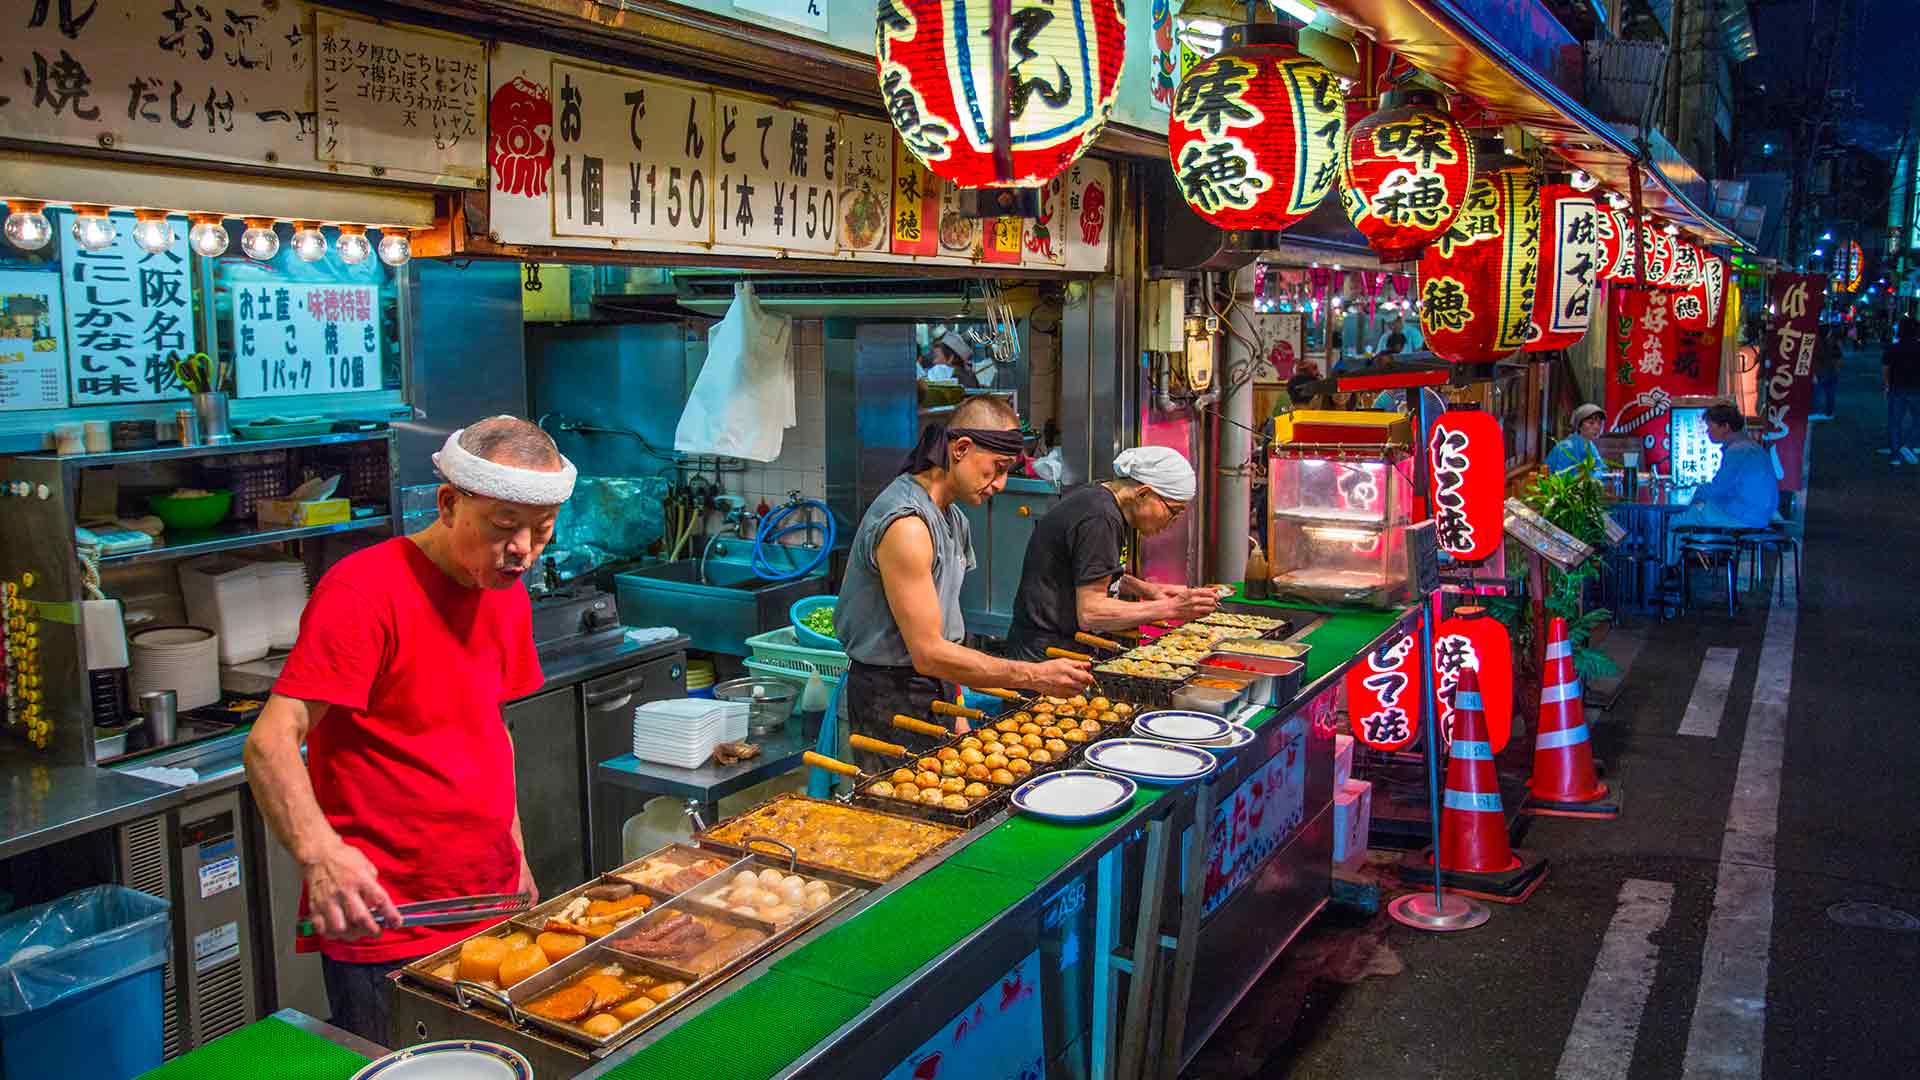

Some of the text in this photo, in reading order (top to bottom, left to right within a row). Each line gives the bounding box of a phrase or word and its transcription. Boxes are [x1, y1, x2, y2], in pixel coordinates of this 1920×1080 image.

[339, 38, 353, 73] スジ
[356, 41, 370, 98] タマゴ
[370, 44, 386, 104] 厚揚げ
[386, 47, 401, 104] ひら天
[416, 53, 432, 112] ちくわ
[447, 60, 463, 149] コンニャク
[462, 62, 478, 136] だいこん
[560, 73, 704, 160] おでん
[720, 104, 836, 182] どて焼き
[1175, 60, 1263, 211] 味穂
[560, 153, 705, 229] 1個 ¥150
[1373, 117, 1453, 226] 味穂
[719, 174, 754, 237] 1本
[773, 181, 835, 241] ¥150
[240, 321, 376, 356] たこ焼き
[329, 356, 365, 389] 10個
